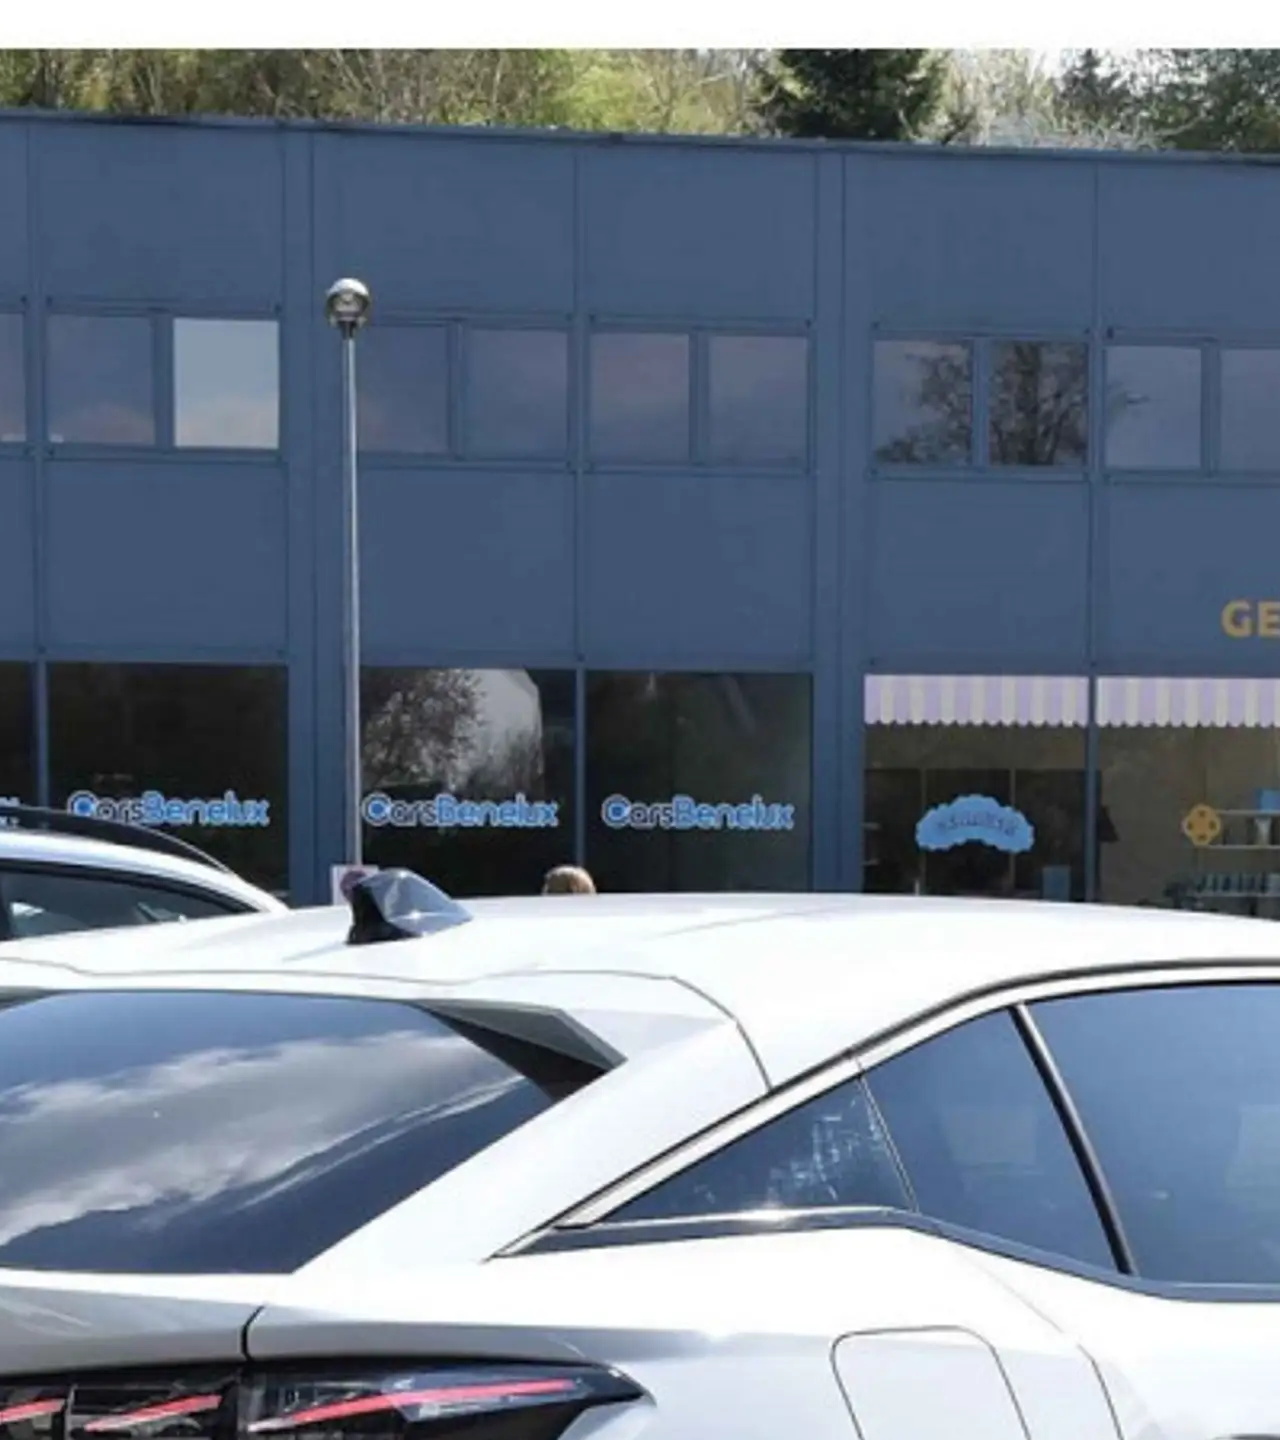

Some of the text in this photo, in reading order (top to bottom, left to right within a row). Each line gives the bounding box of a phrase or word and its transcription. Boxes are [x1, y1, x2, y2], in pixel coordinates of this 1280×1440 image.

[67, 789, 270, 826] CarsBenelux
[361, 792, 559, 828] CarsBenelux
[601, 793, 795, 829] CarsBenelux
